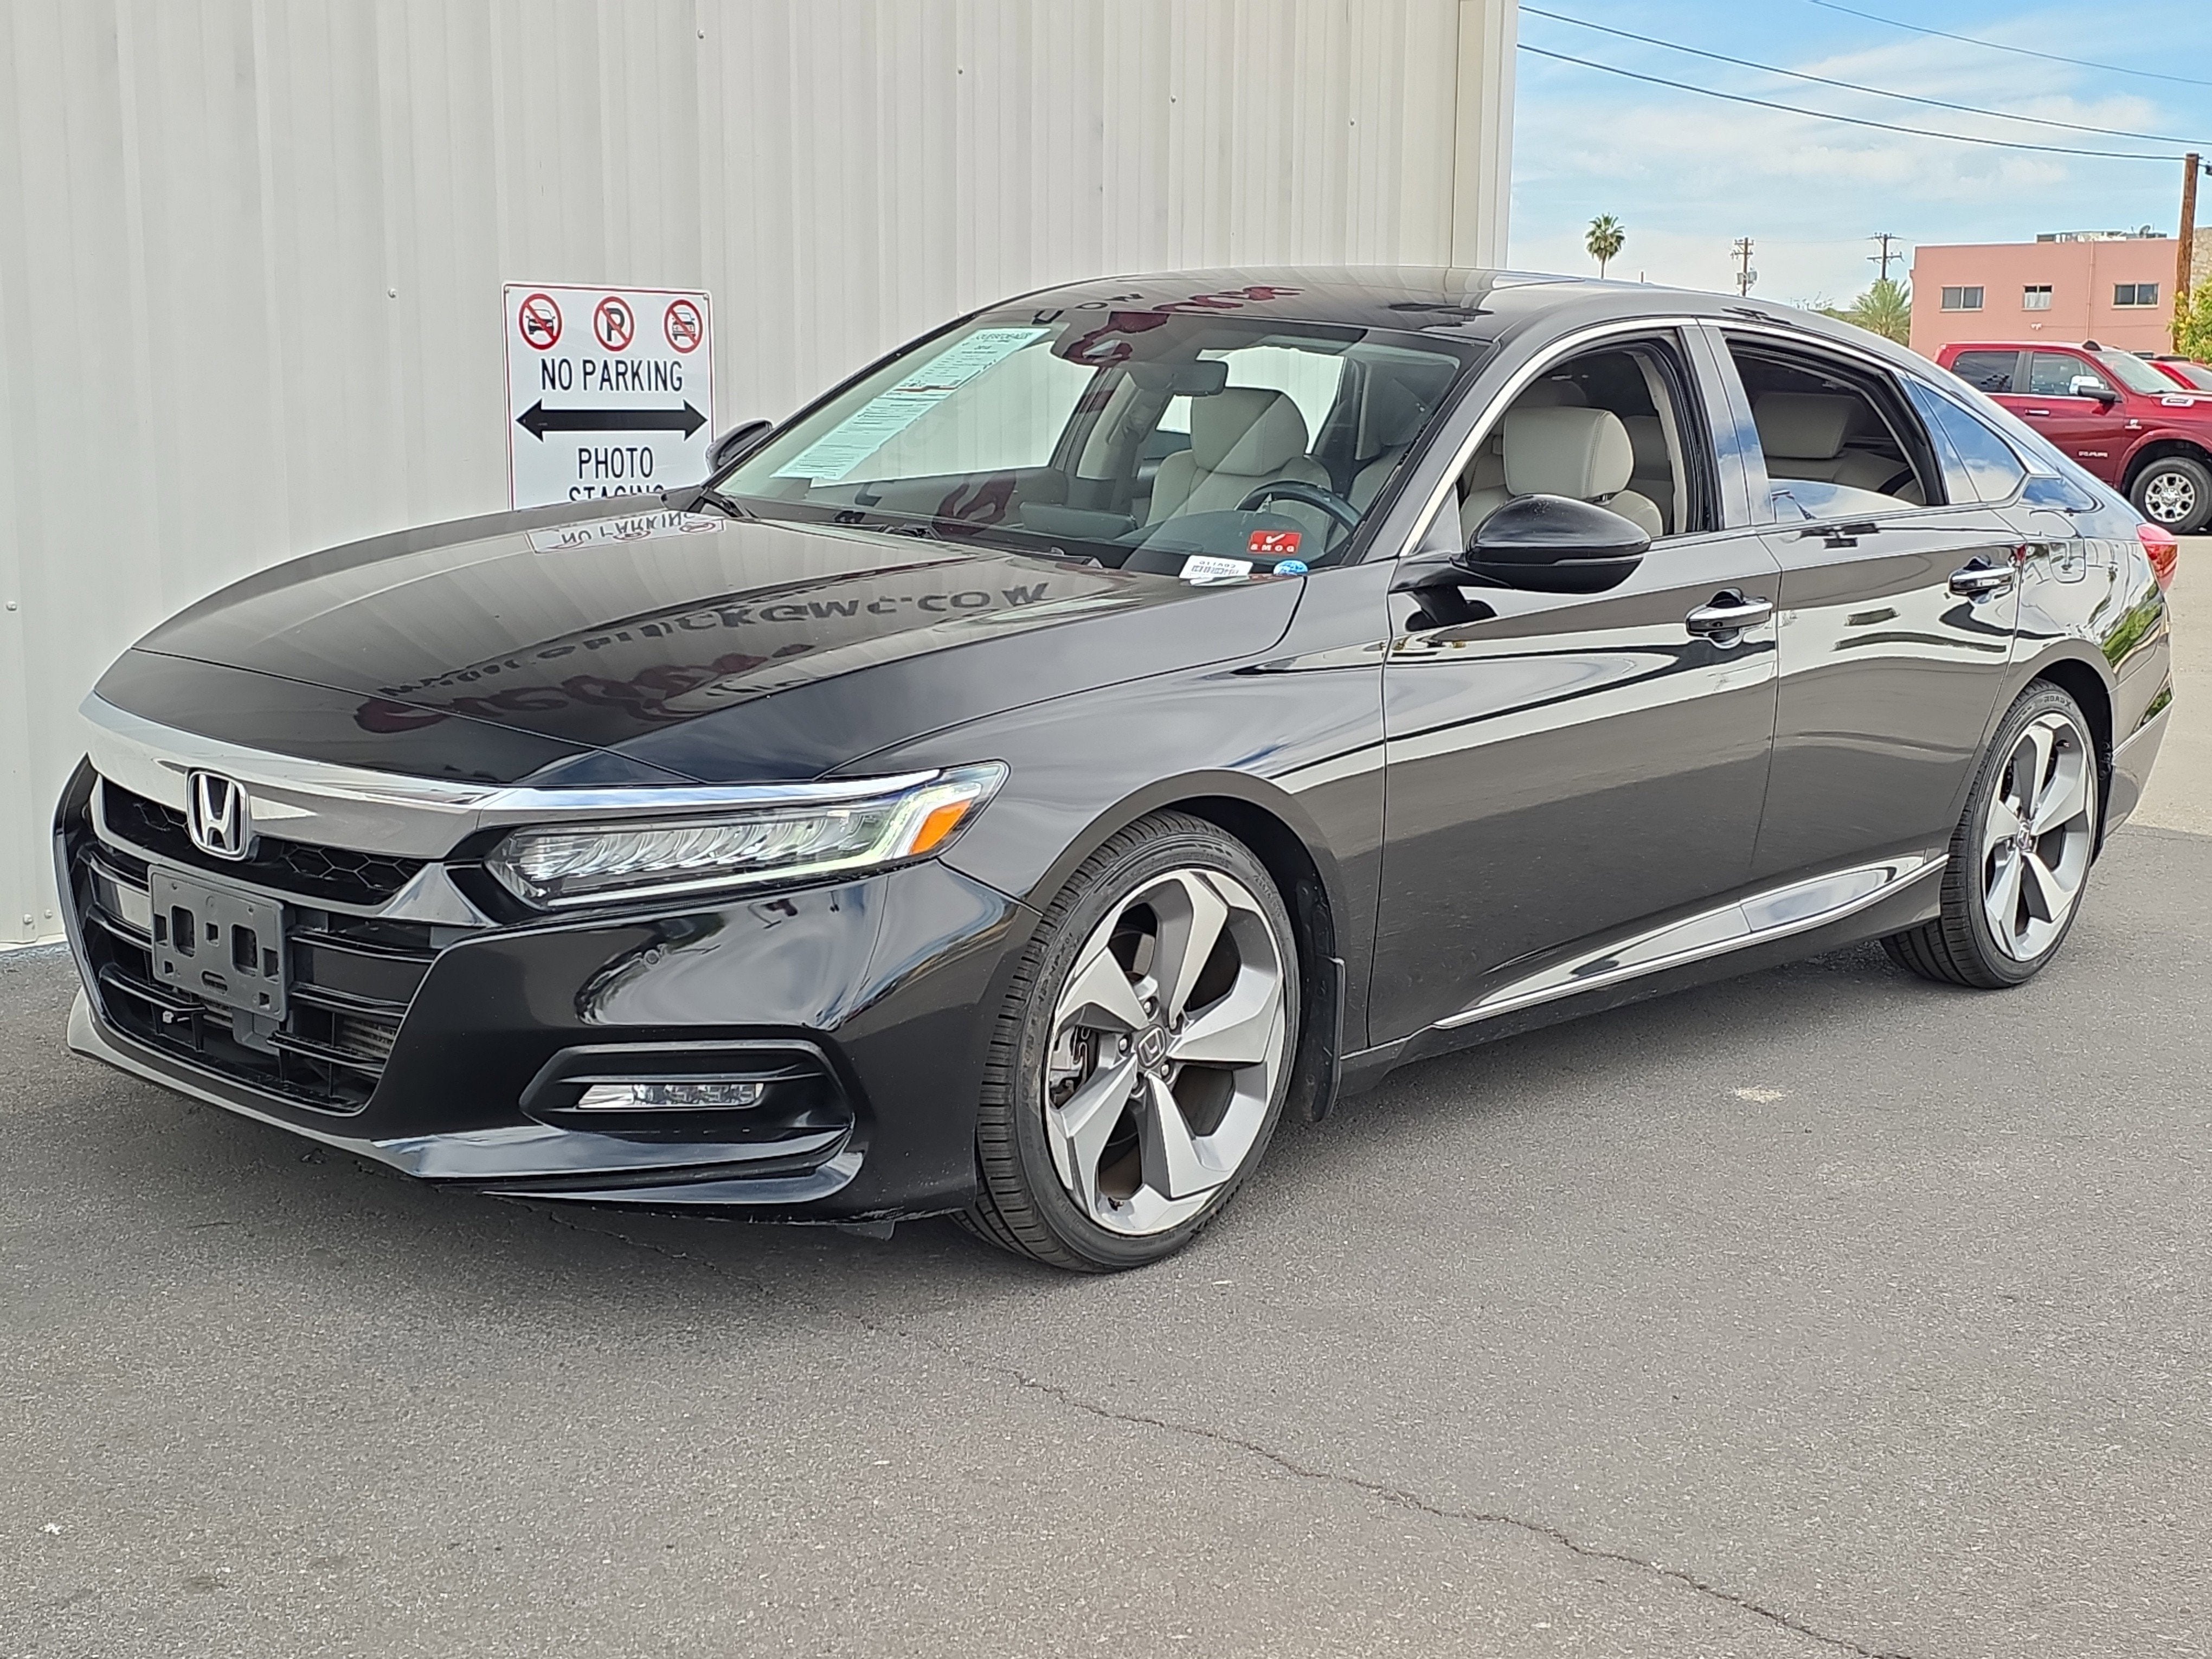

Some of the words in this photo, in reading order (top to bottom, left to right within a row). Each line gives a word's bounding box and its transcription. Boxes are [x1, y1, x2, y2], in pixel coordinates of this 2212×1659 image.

[542, 358, 573, 390] NO
[582, 359, 683, 391] PARKING
[578, 447, 654, 479] PHOTO
